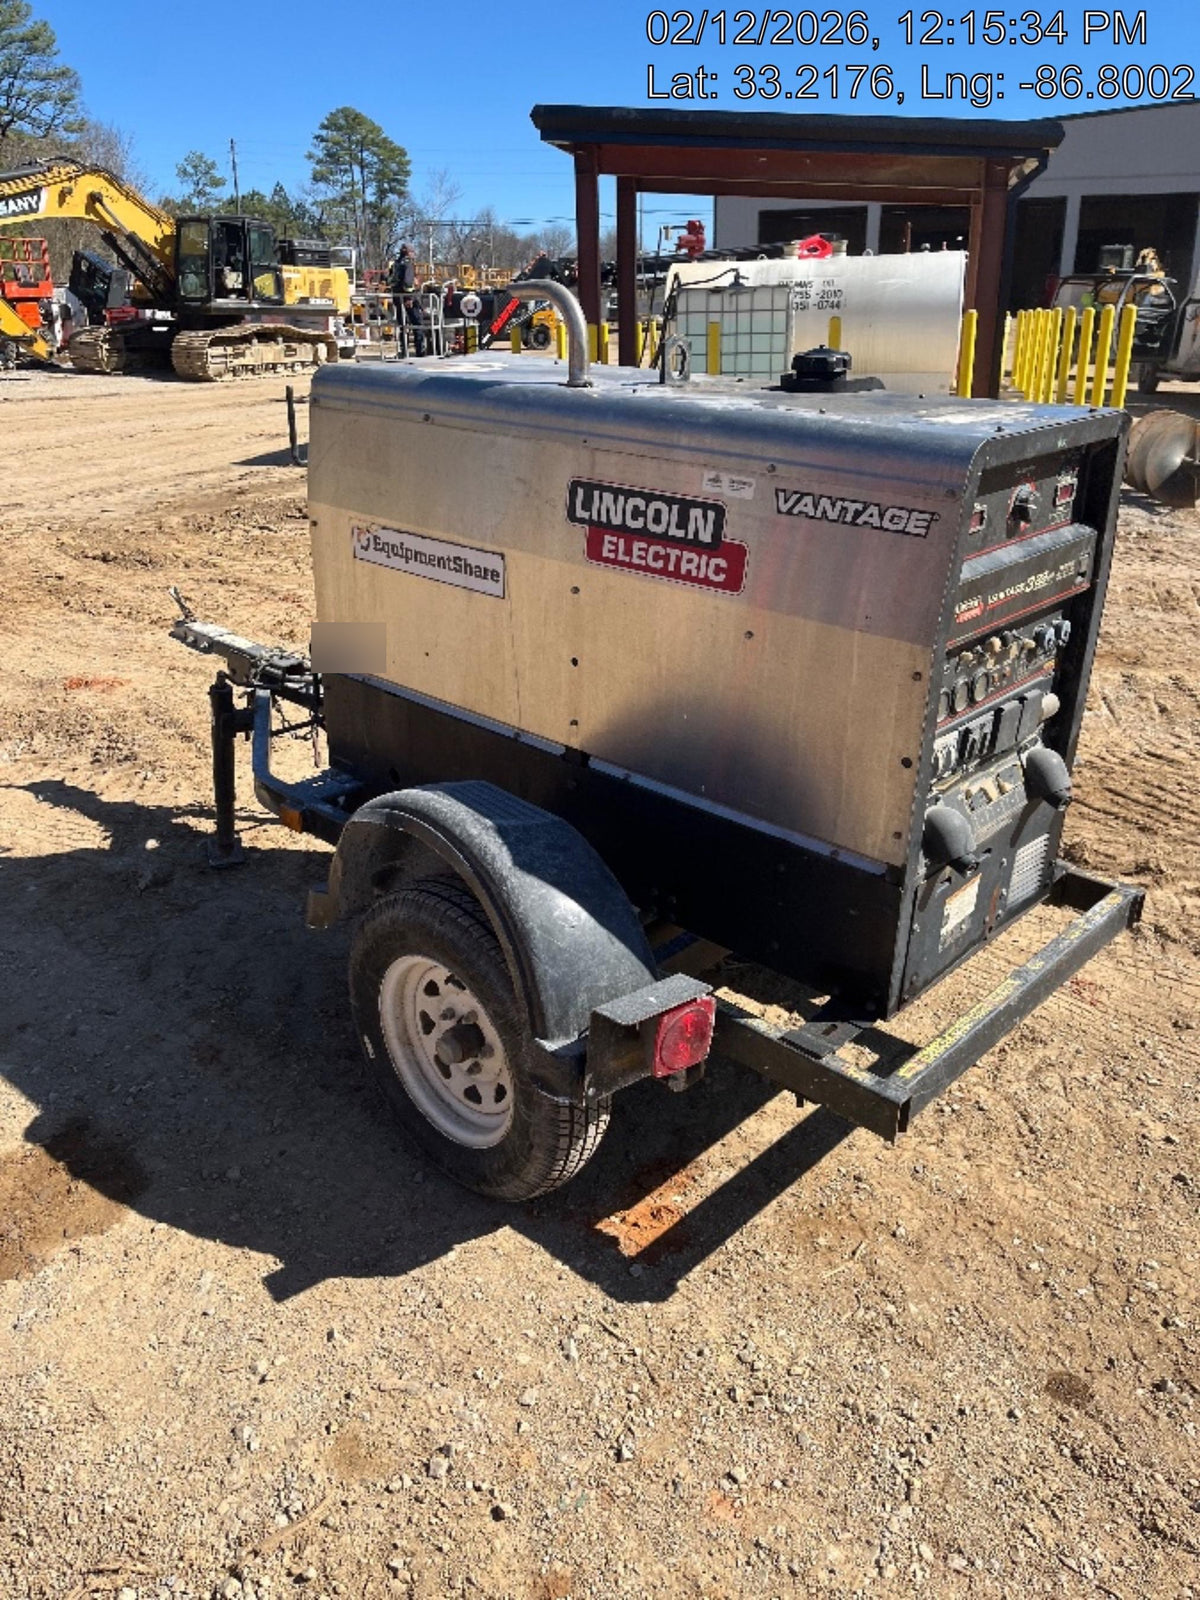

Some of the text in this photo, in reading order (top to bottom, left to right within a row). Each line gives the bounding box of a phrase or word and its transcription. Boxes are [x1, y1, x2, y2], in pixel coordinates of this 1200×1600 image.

[574, 486, 716, 543] LINCOLN
[776, 489, 935, 537] VANTAGE
[373, 534, 501, 583] EquipmentShare
[601, 534, 728, 582] ELECTRIC
